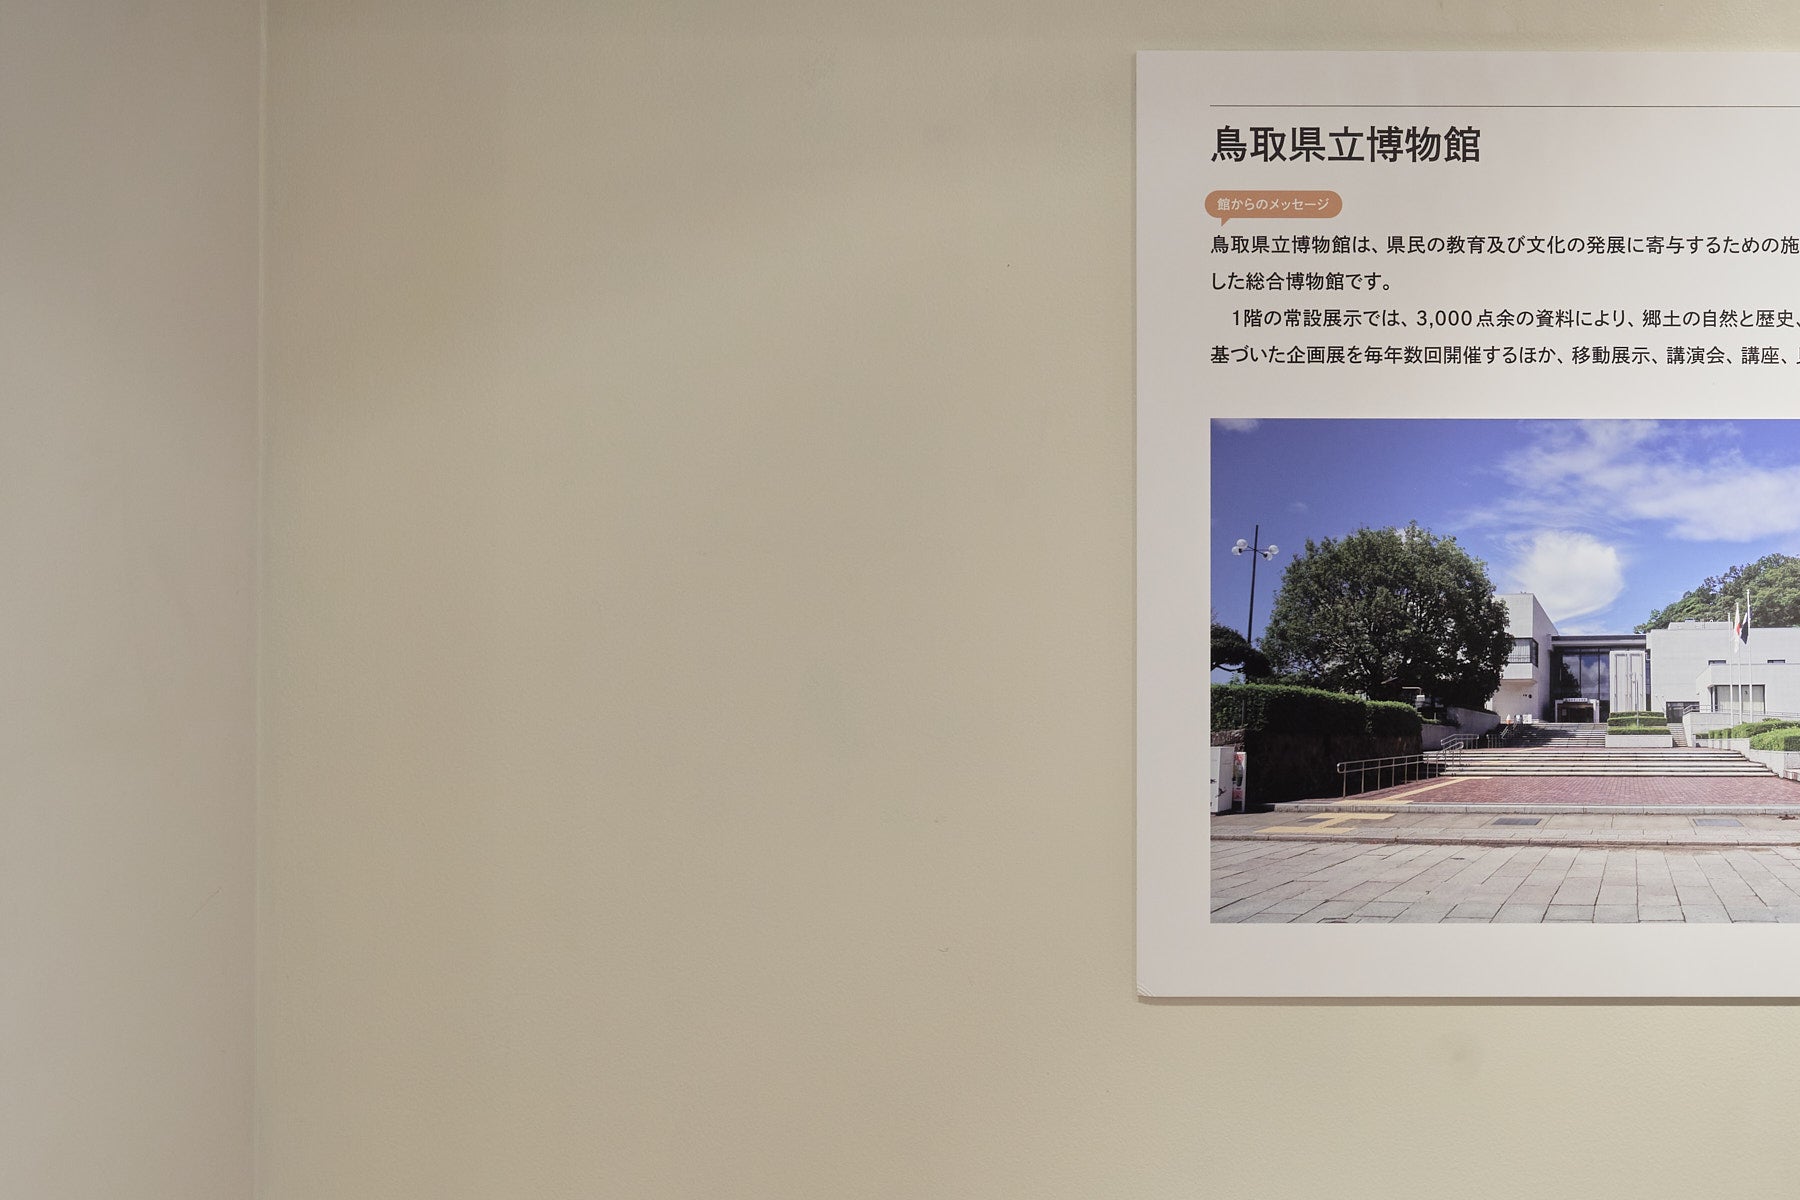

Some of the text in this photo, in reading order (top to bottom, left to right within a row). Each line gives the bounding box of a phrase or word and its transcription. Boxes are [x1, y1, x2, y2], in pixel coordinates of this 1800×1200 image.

[1211, 126, 1480, 162] 鳥取県立博物館
[1217, 197, 1329, 212] 館からのメッセージ
[1213, 272, 1389, 290] した総合博物館です。
